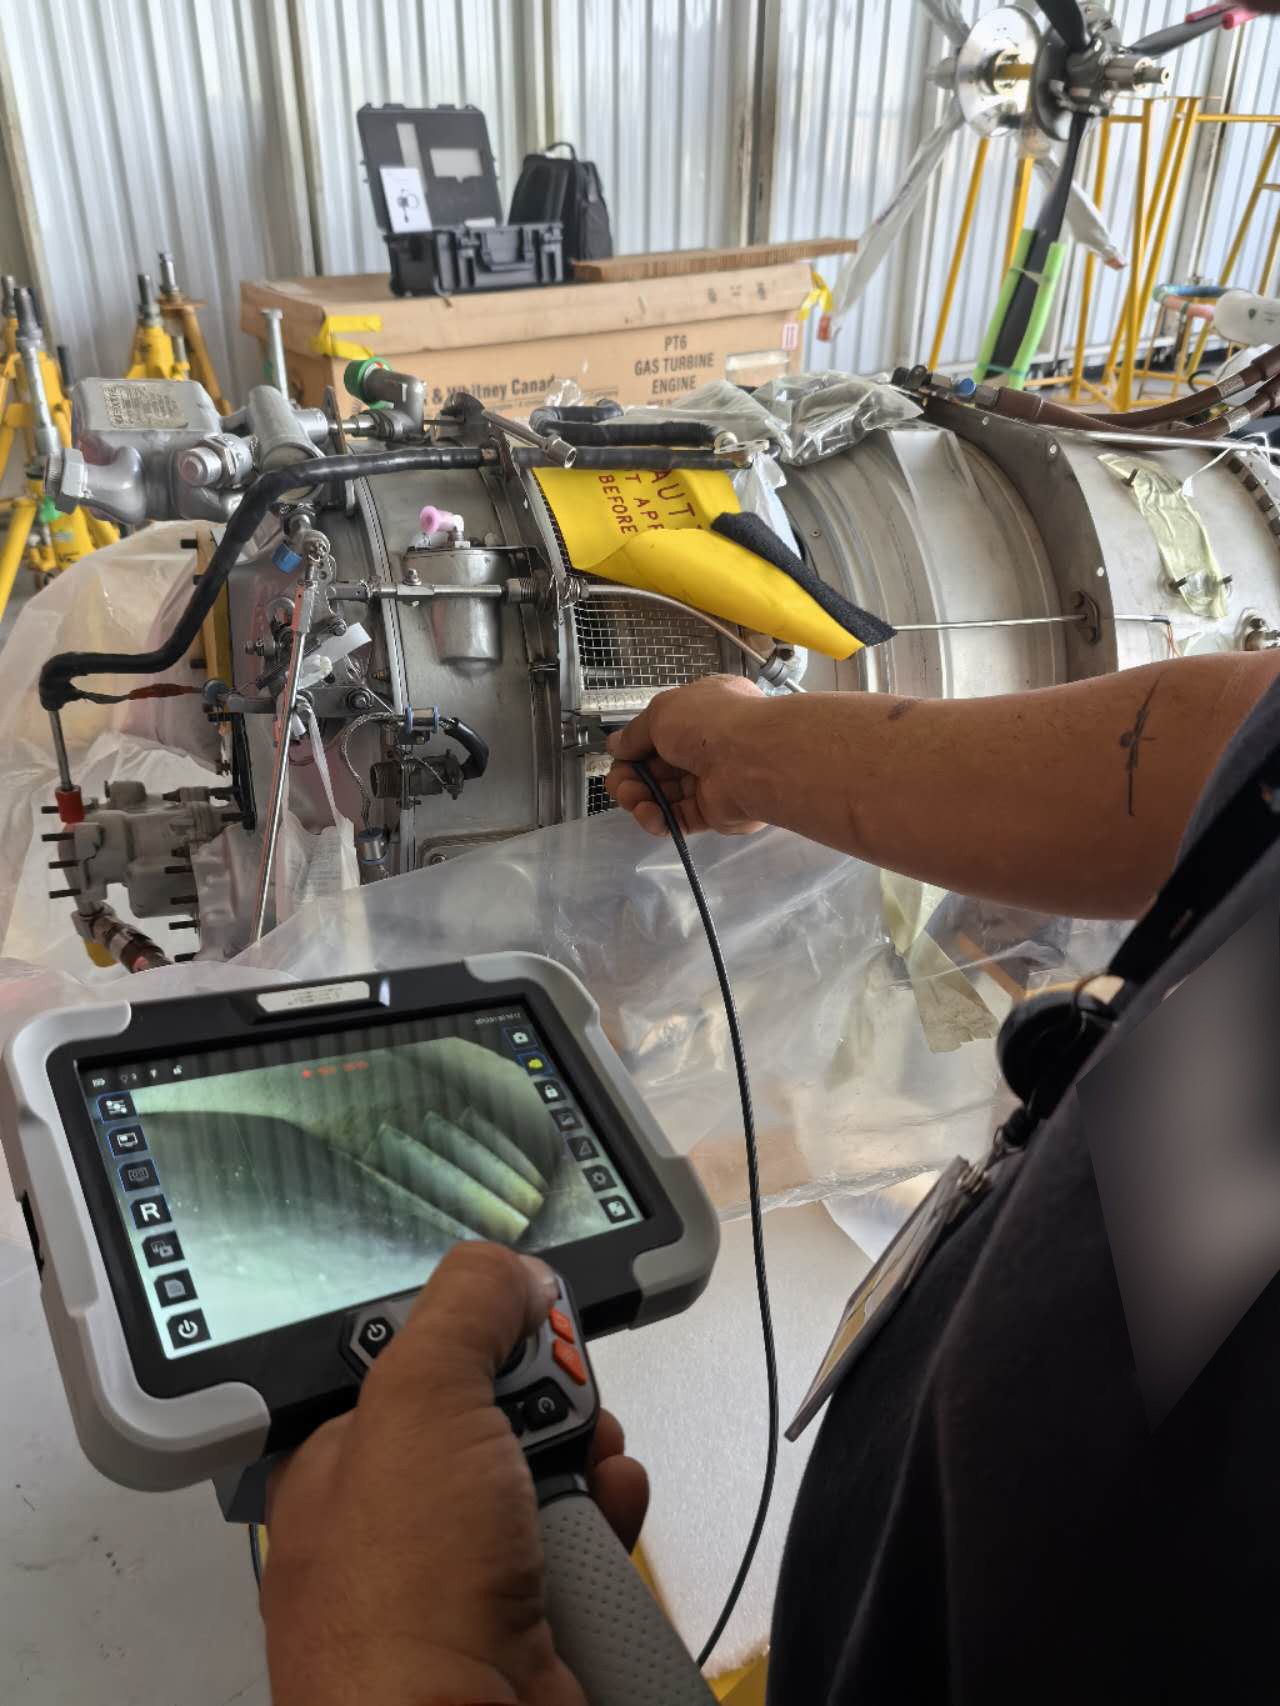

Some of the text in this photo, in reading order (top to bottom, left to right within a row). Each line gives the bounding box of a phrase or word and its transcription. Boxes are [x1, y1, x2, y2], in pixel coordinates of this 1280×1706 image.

[664, 334, 688, 351] PT6
[634, 353, 715, 376] GAS TURBINE
[511, 373, 555, 396] Canad
[651, 375, 697, 395] ENGINE
[598, 474, 639, 535] BEFORE
[650, 468, 704, 530] AUT
[139, 1202, 161, 1222] R
